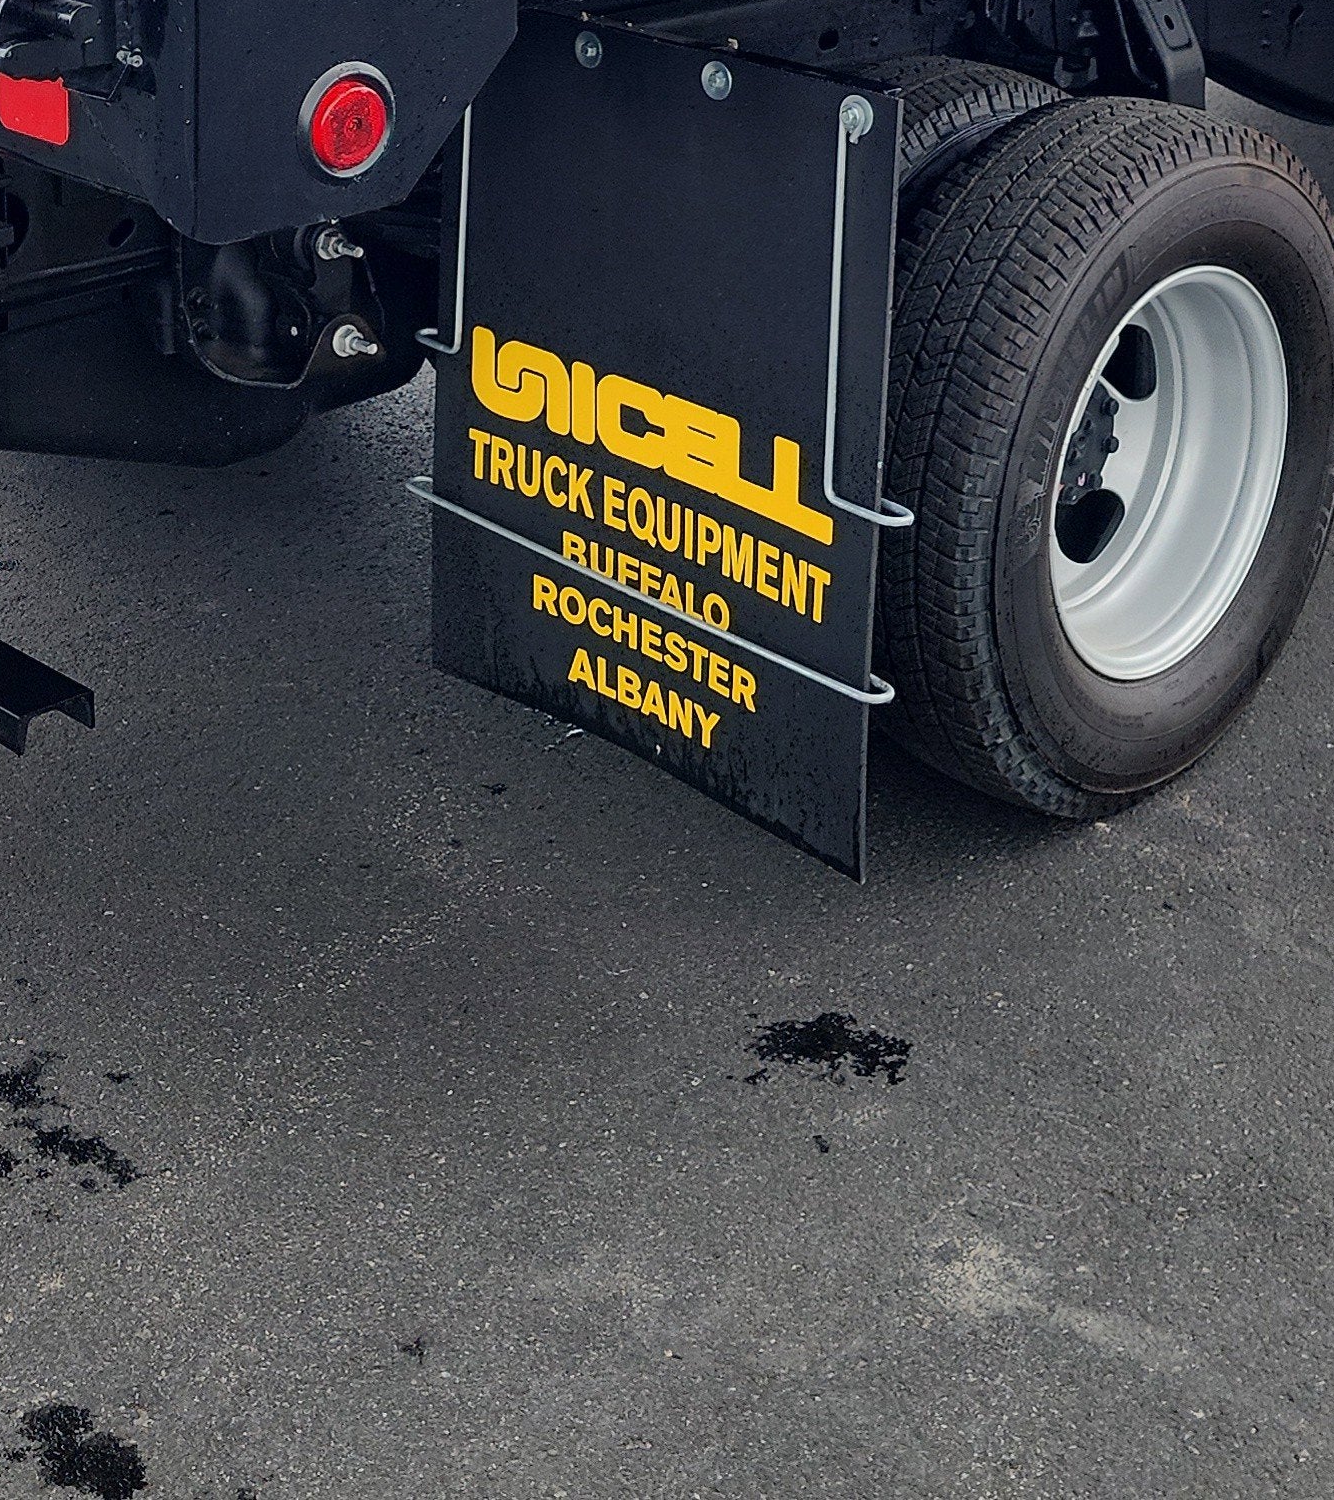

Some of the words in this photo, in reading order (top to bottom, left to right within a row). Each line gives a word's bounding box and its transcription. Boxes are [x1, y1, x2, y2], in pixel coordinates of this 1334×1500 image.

[471, 325, 834, 546] UNICELL
[468, 427, 595, 520] TRUCK
[603, 477, 833, 624] EQUIPMENT
[562, 531, 731, 635] BUFFALO
[532, 574, 758, 714] ROCHESTER
[567, 647, 721, 750] ALBANY
